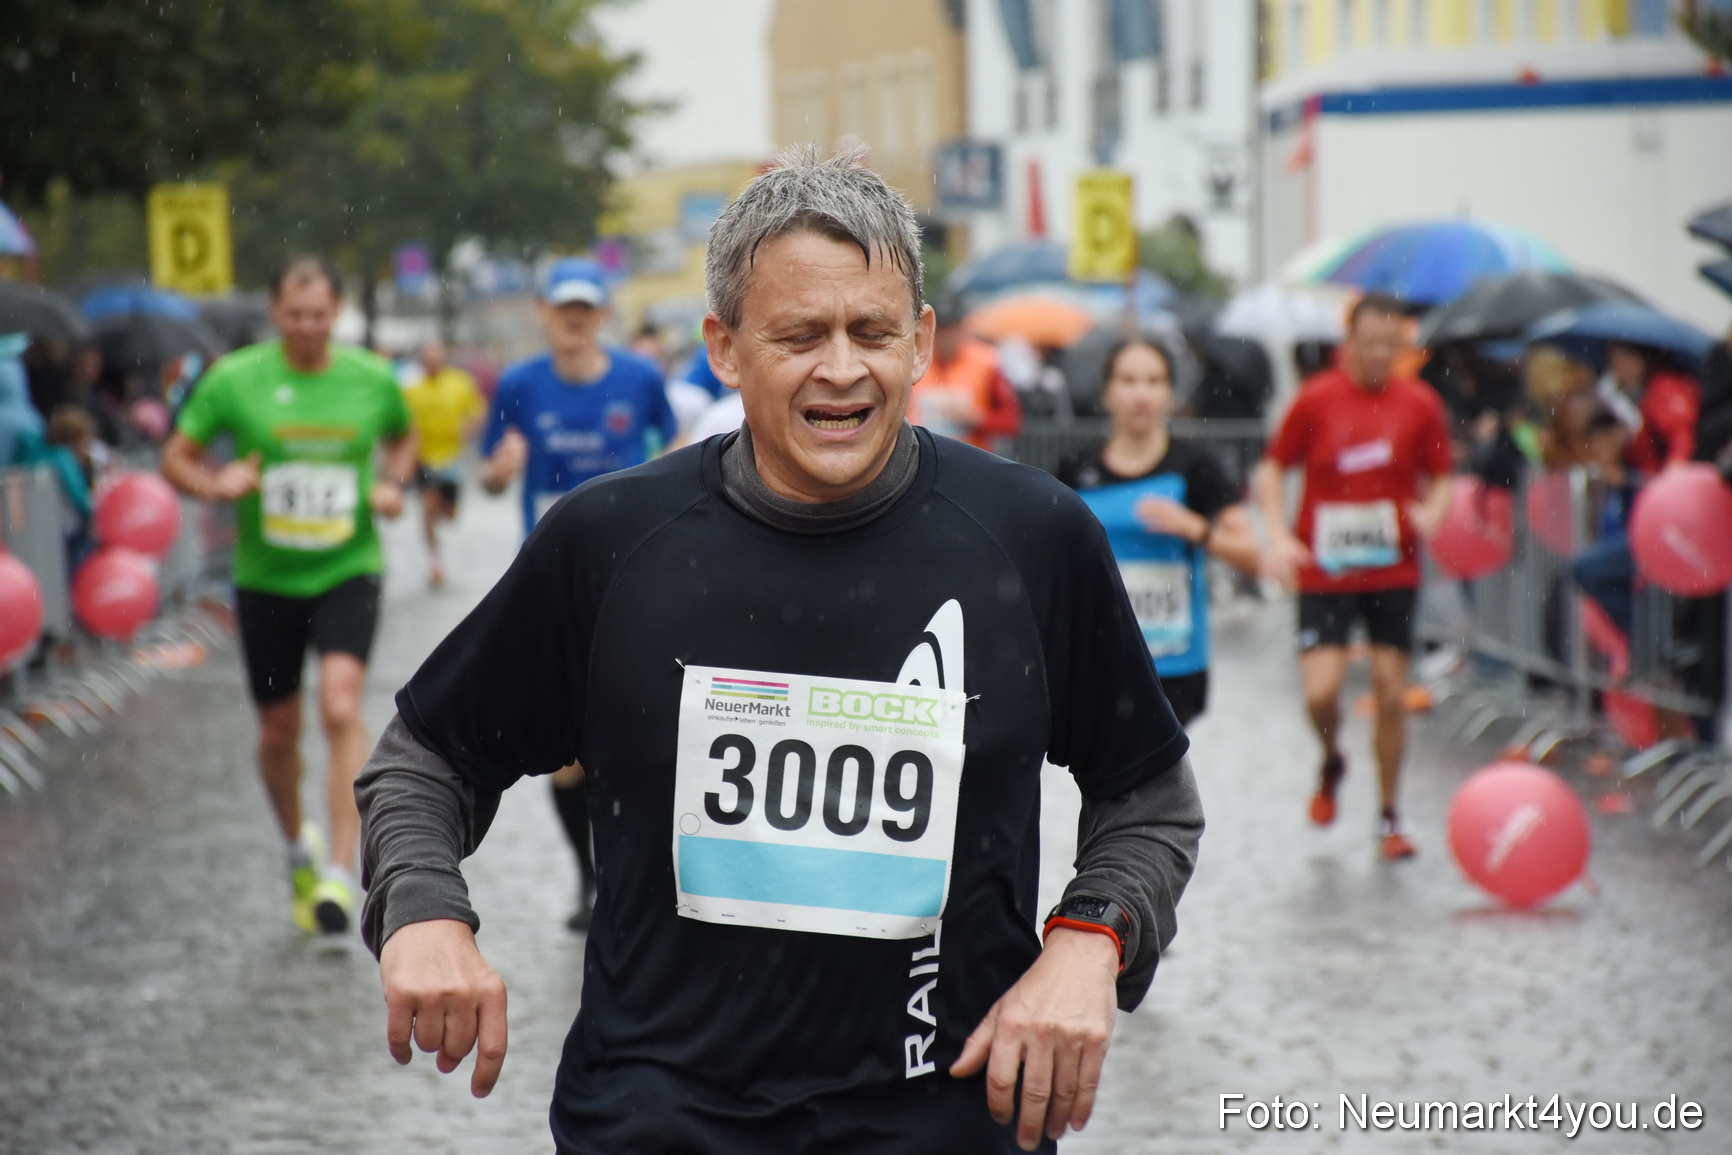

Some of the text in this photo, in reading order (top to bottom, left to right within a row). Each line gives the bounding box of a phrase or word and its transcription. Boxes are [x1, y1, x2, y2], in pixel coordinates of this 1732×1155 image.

[704, 698, 792, 718] NeuerMarkt
[809, 688, 938, 726] BOCK
[806, 718, 940, 738] inspired by smart concepts
[704, 733, 934, 843] 3009
